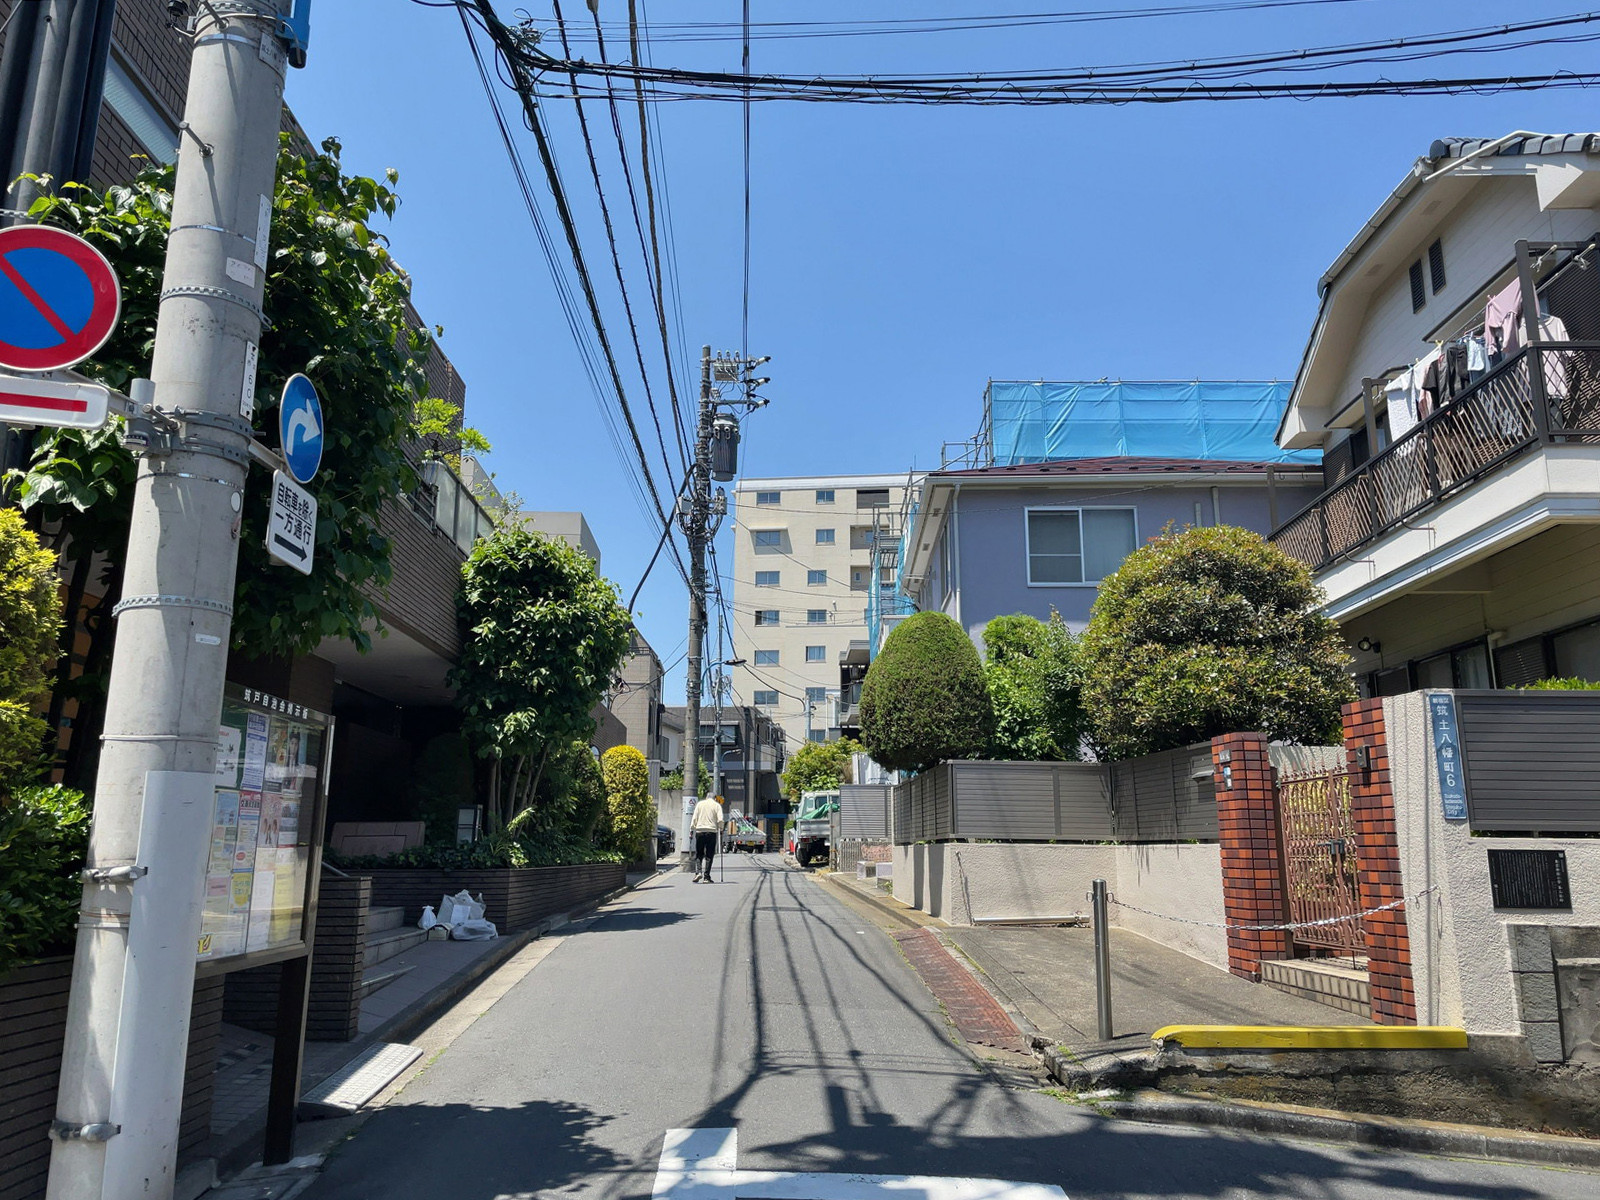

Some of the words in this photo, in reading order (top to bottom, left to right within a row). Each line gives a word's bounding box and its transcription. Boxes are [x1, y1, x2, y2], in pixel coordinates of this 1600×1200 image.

[277, 482, 312, 524] 自転車を除く
[275, 512, 312, 545] 一方通行
